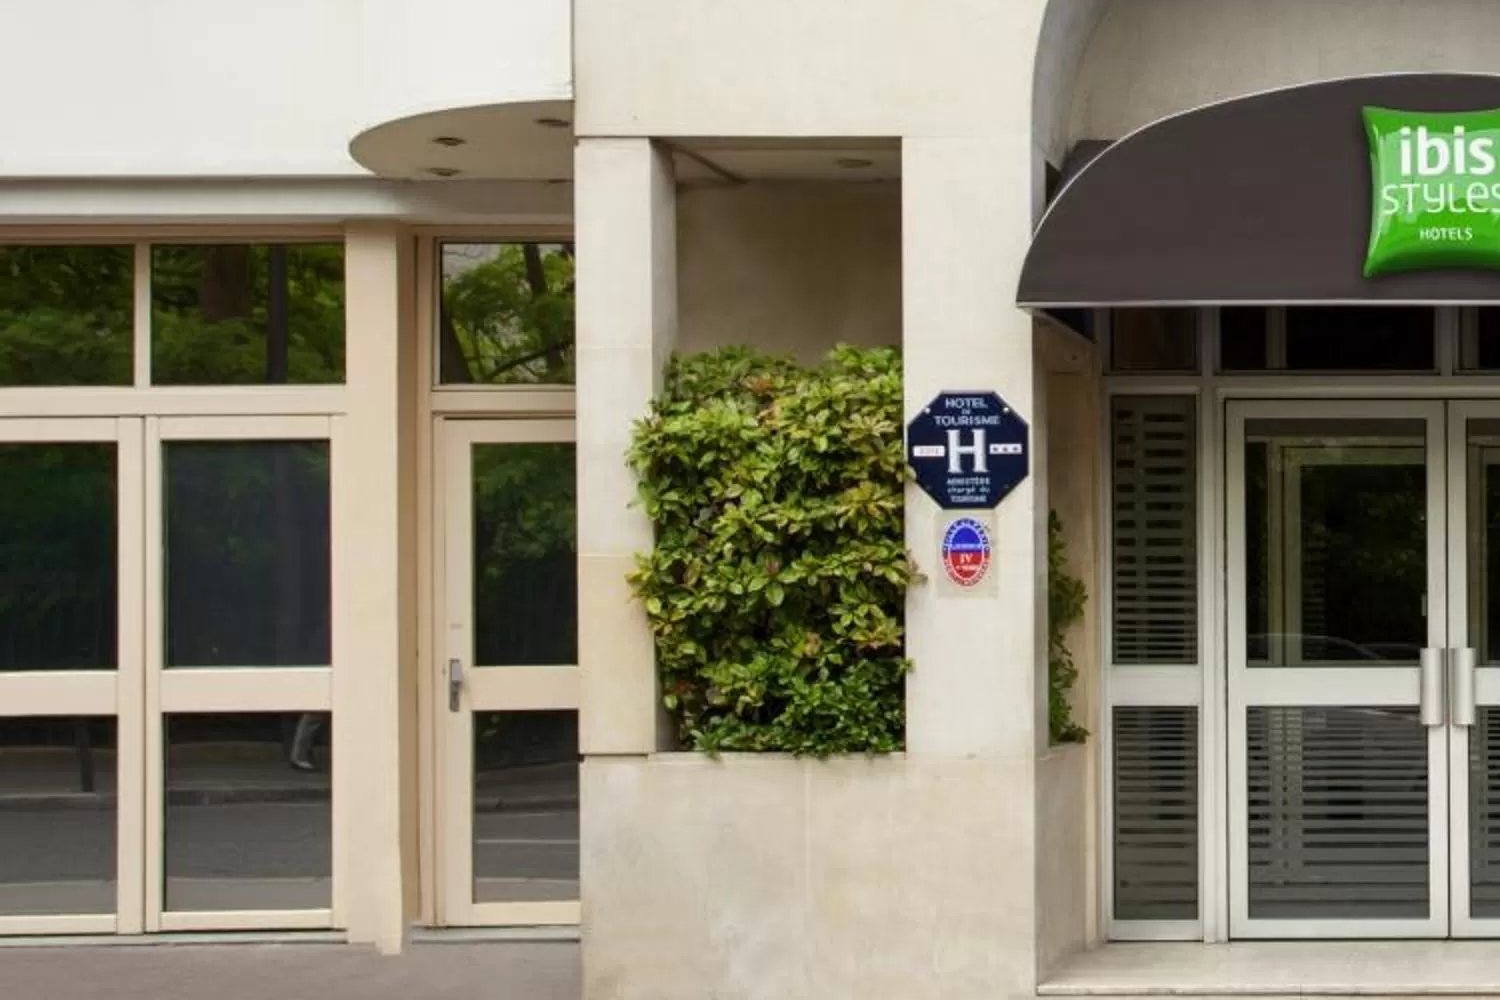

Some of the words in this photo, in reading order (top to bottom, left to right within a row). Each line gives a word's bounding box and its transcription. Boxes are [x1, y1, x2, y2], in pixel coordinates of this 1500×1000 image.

[1400, 125, 1496, 176] ibis
[1419, 227, 1473, 241] HOTELS
[944, 397, 988, 409] HOTEL
[933, 415, 1001, 427] TOURISME
[945, 428, 990, 474] H
